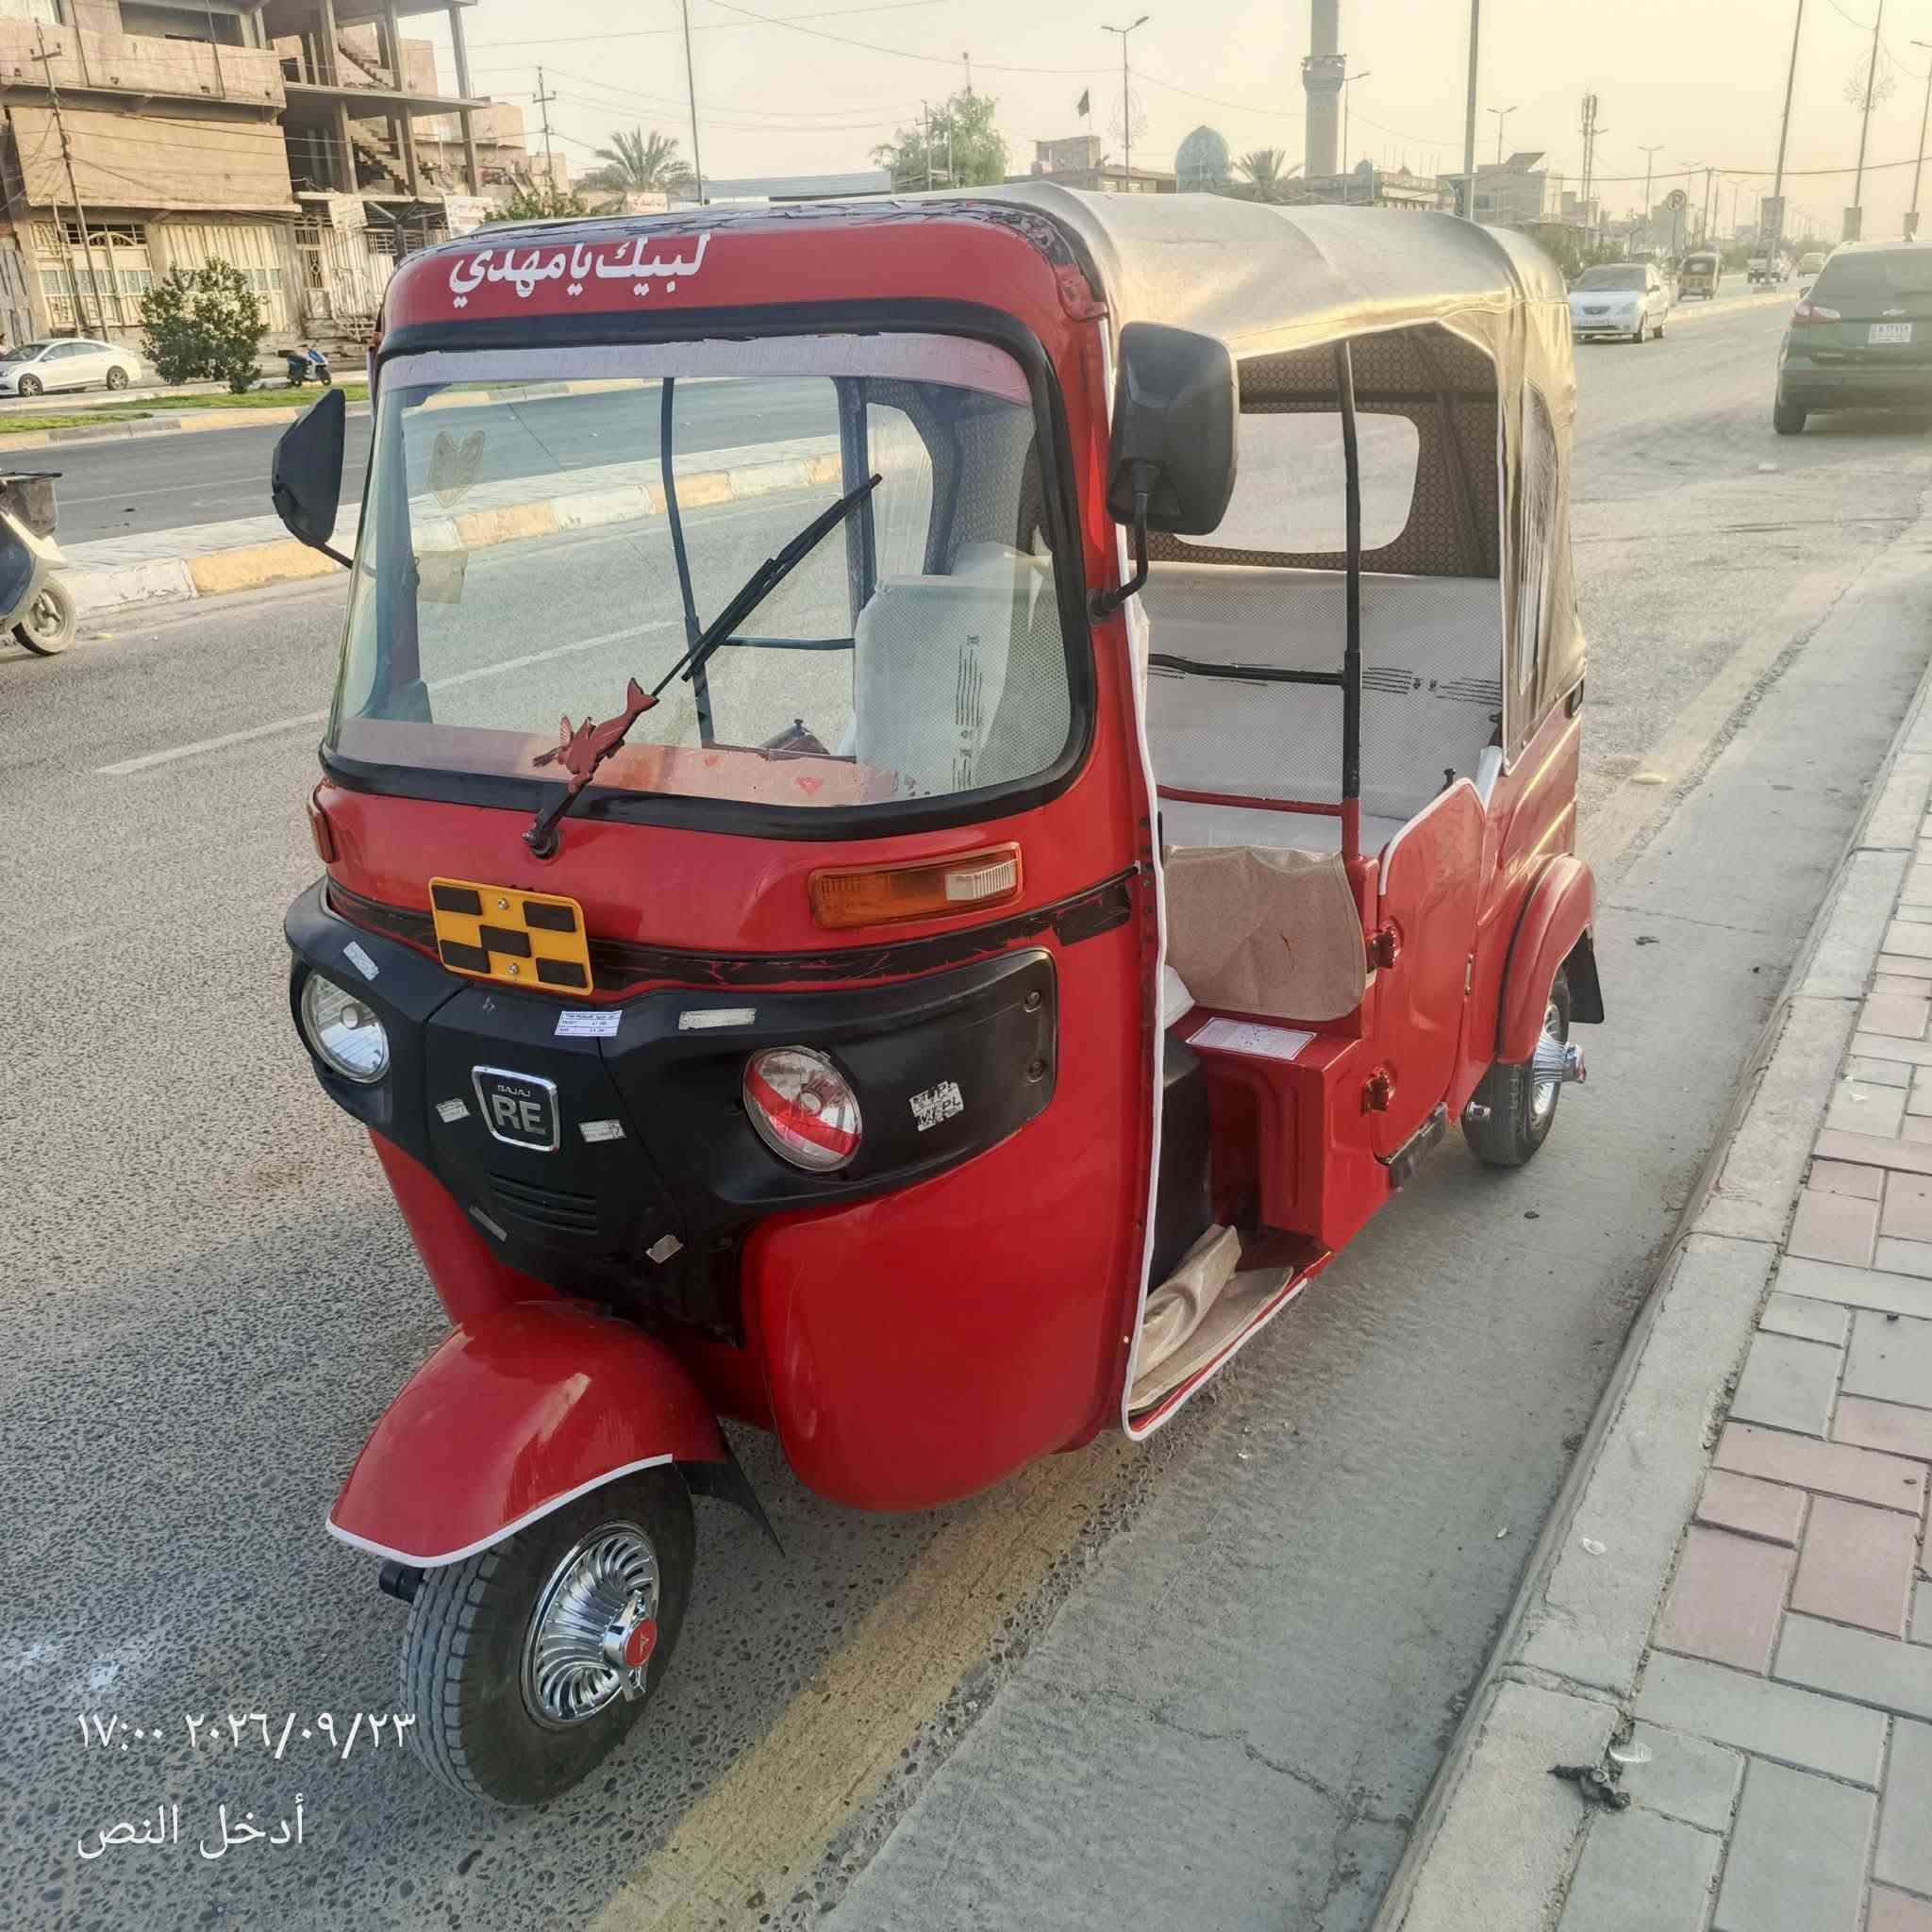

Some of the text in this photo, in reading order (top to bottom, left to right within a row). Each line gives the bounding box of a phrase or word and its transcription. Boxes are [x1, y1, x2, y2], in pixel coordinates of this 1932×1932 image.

[595, 233, 711, 296] لبيك
[497, 1084, 532, 1098] BAJAJ
[491, 1093, 547, 1136] RE
